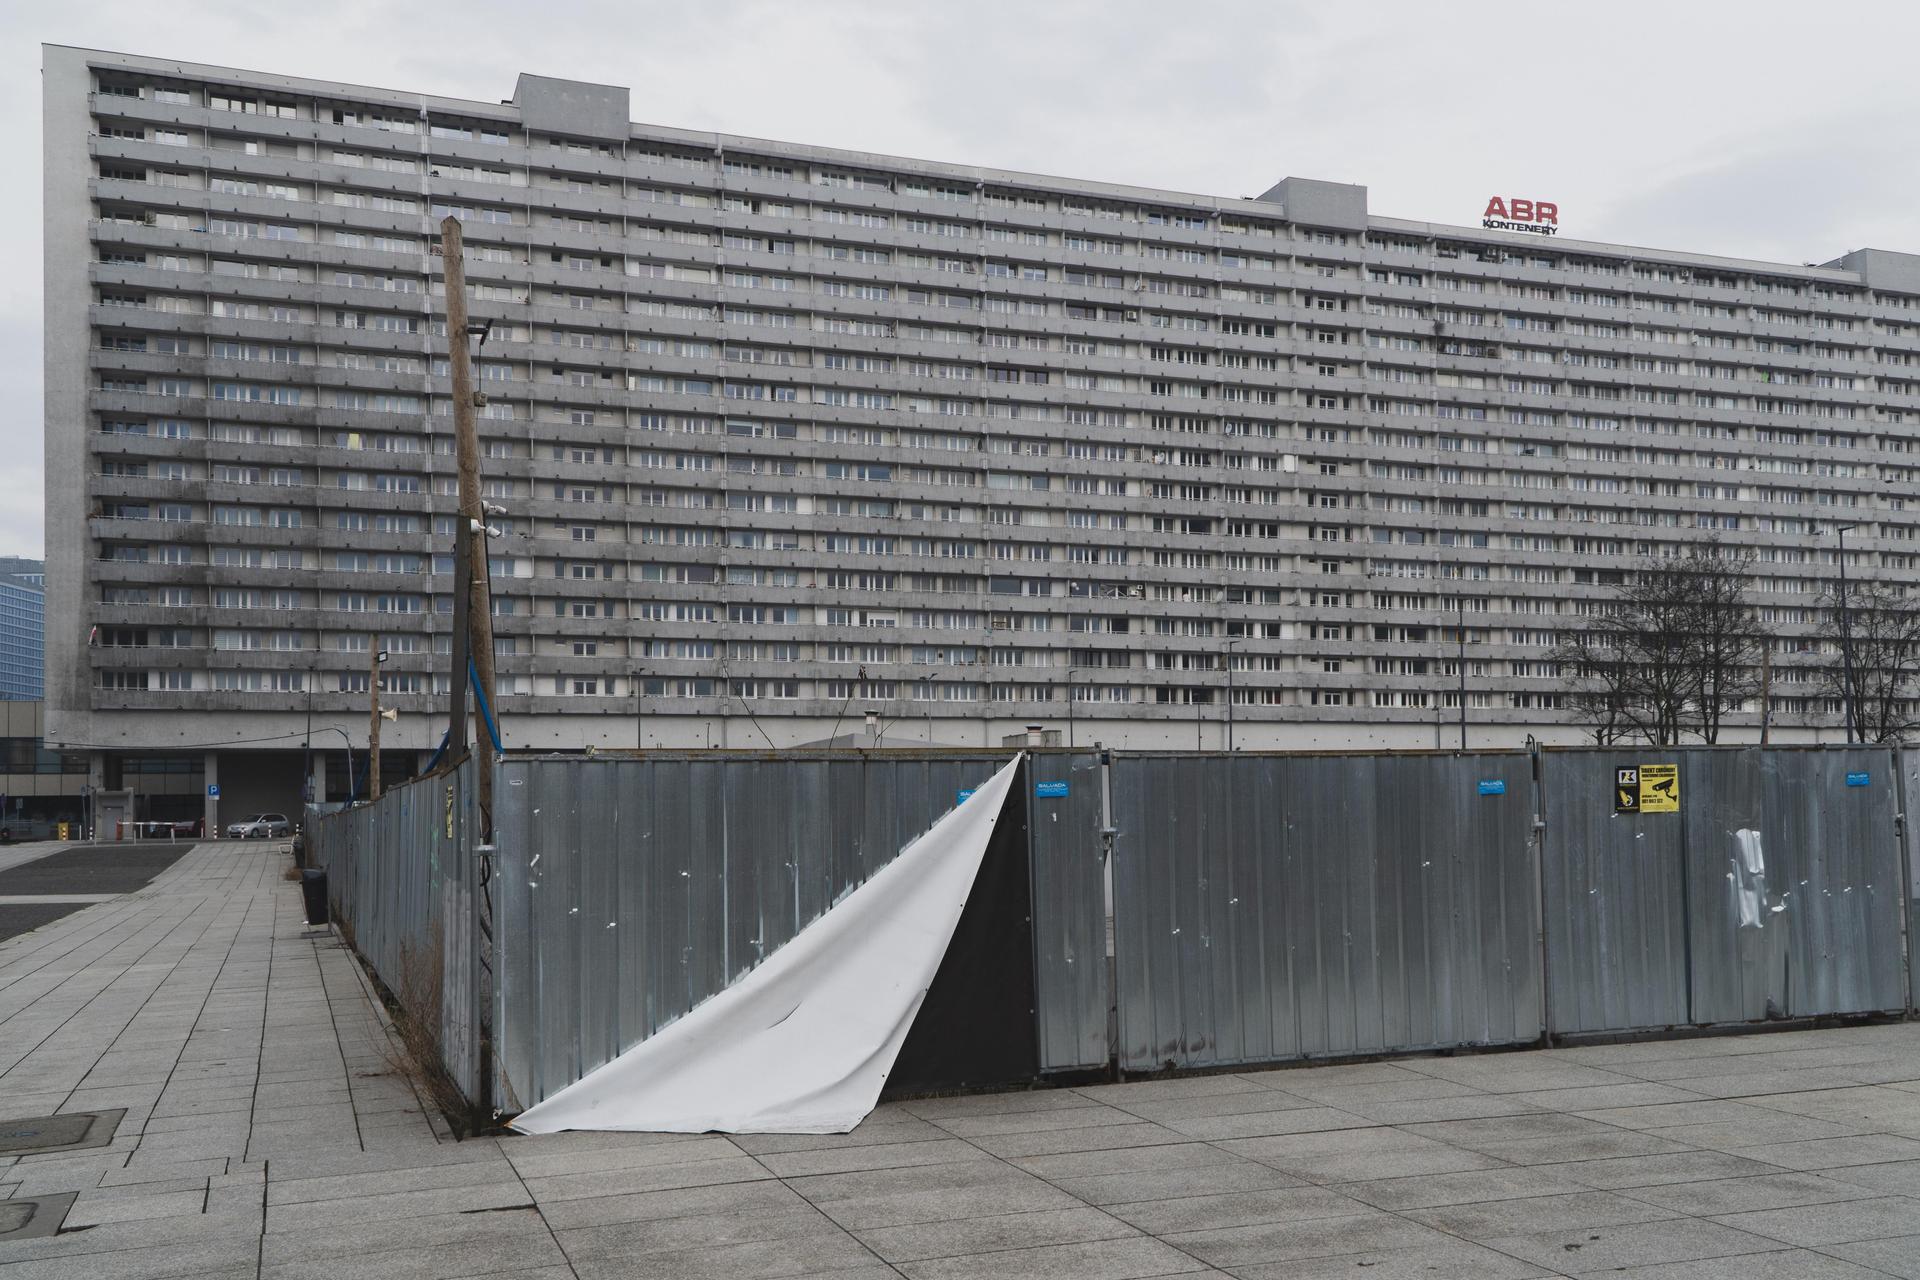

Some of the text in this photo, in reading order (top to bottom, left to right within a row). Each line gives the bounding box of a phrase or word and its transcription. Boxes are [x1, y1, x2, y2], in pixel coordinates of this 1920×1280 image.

[1484, 196, 1558, 225] ABR
[1482, 219, 1558, 235] KONTENERY
[211, 786, 217, 794] P
